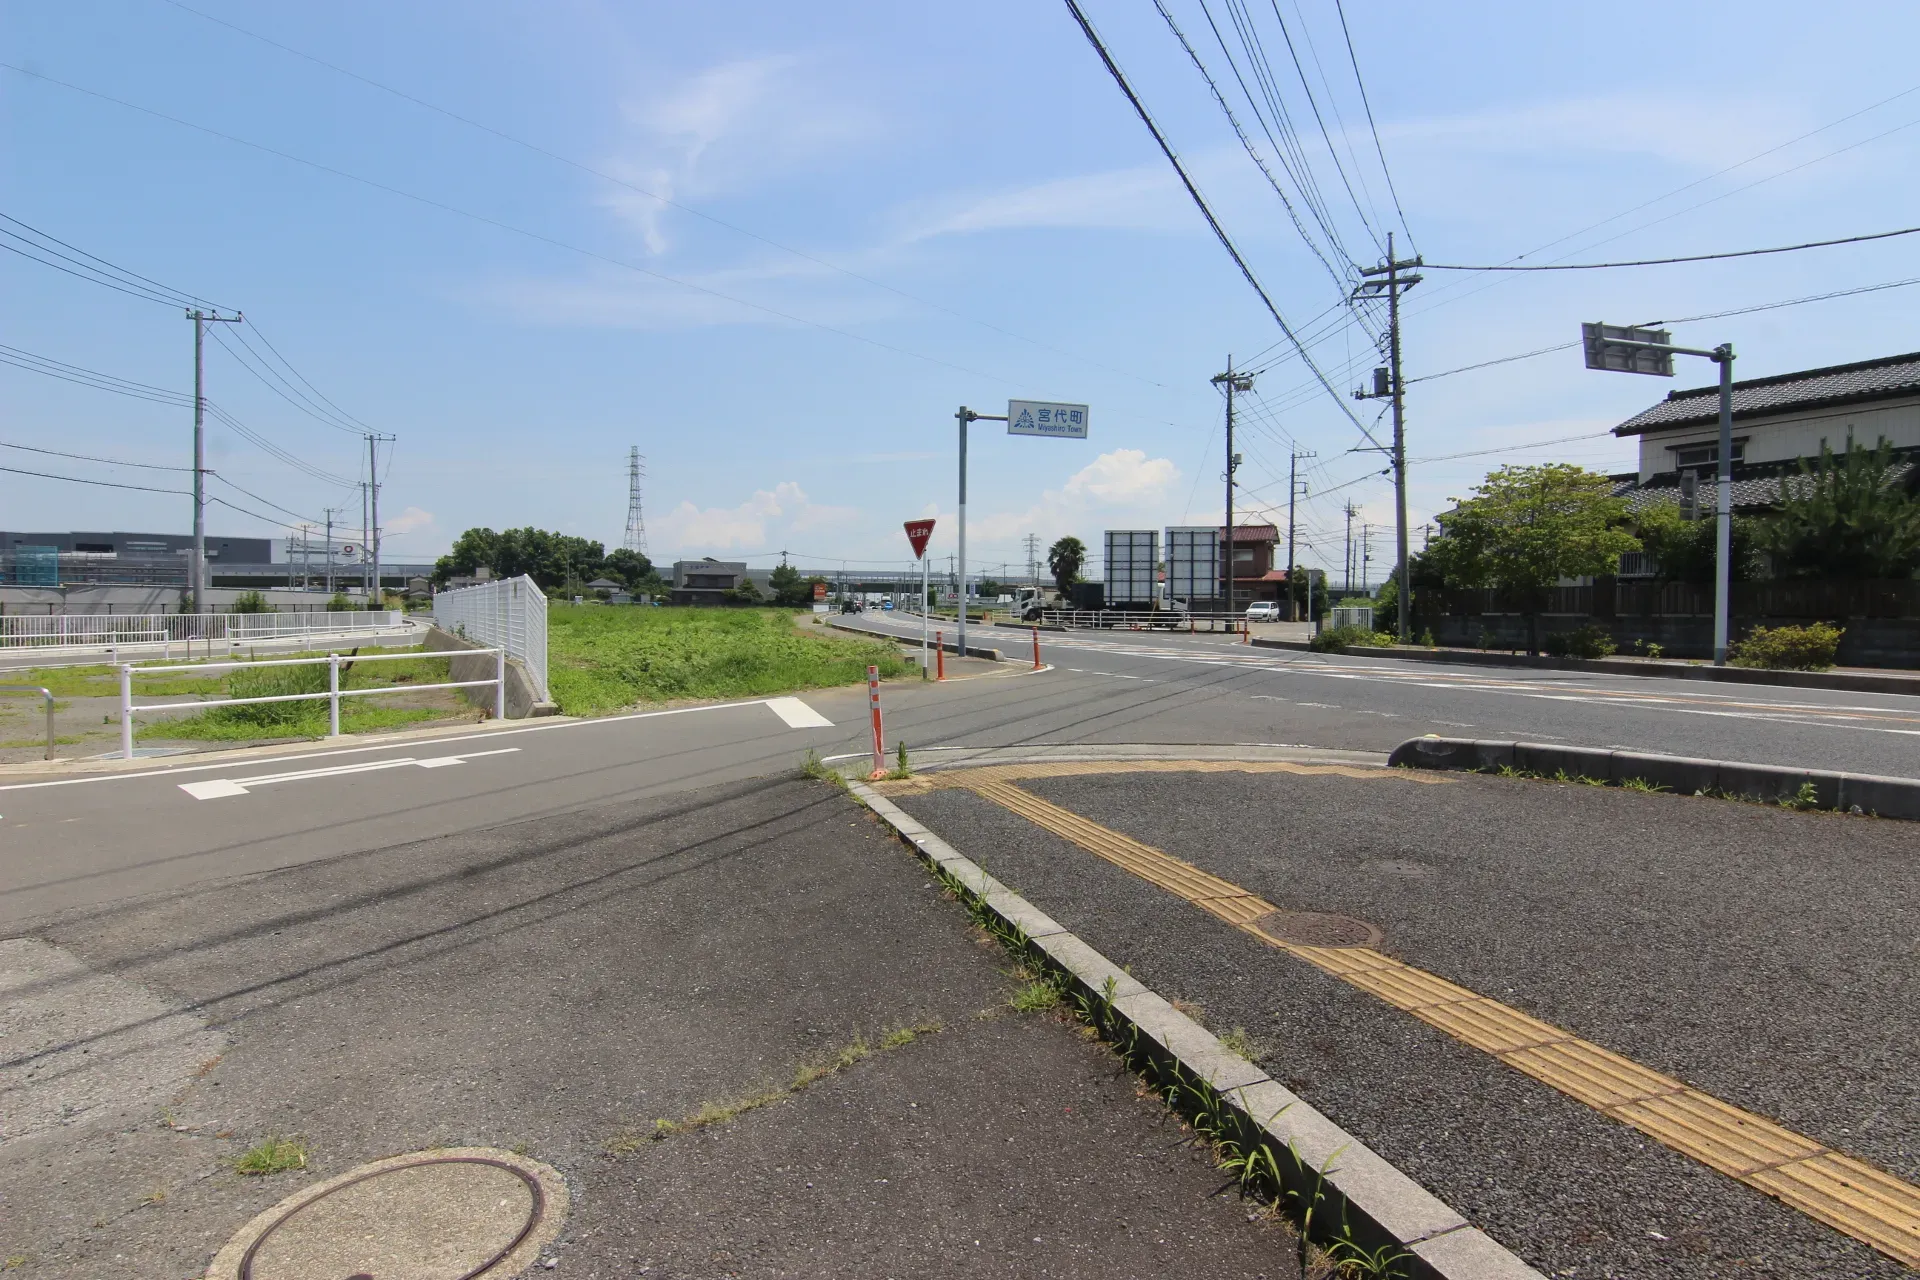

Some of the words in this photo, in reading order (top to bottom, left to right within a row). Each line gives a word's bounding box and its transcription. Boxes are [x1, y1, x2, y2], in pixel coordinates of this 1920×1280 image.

[1038, 408, 1083, 424] 宮代町
[1038, 423, 1066, 433] Miyashiro
[1068, 425, 1082, 433] Town
[910, 527, 929, 538] 止まれ
